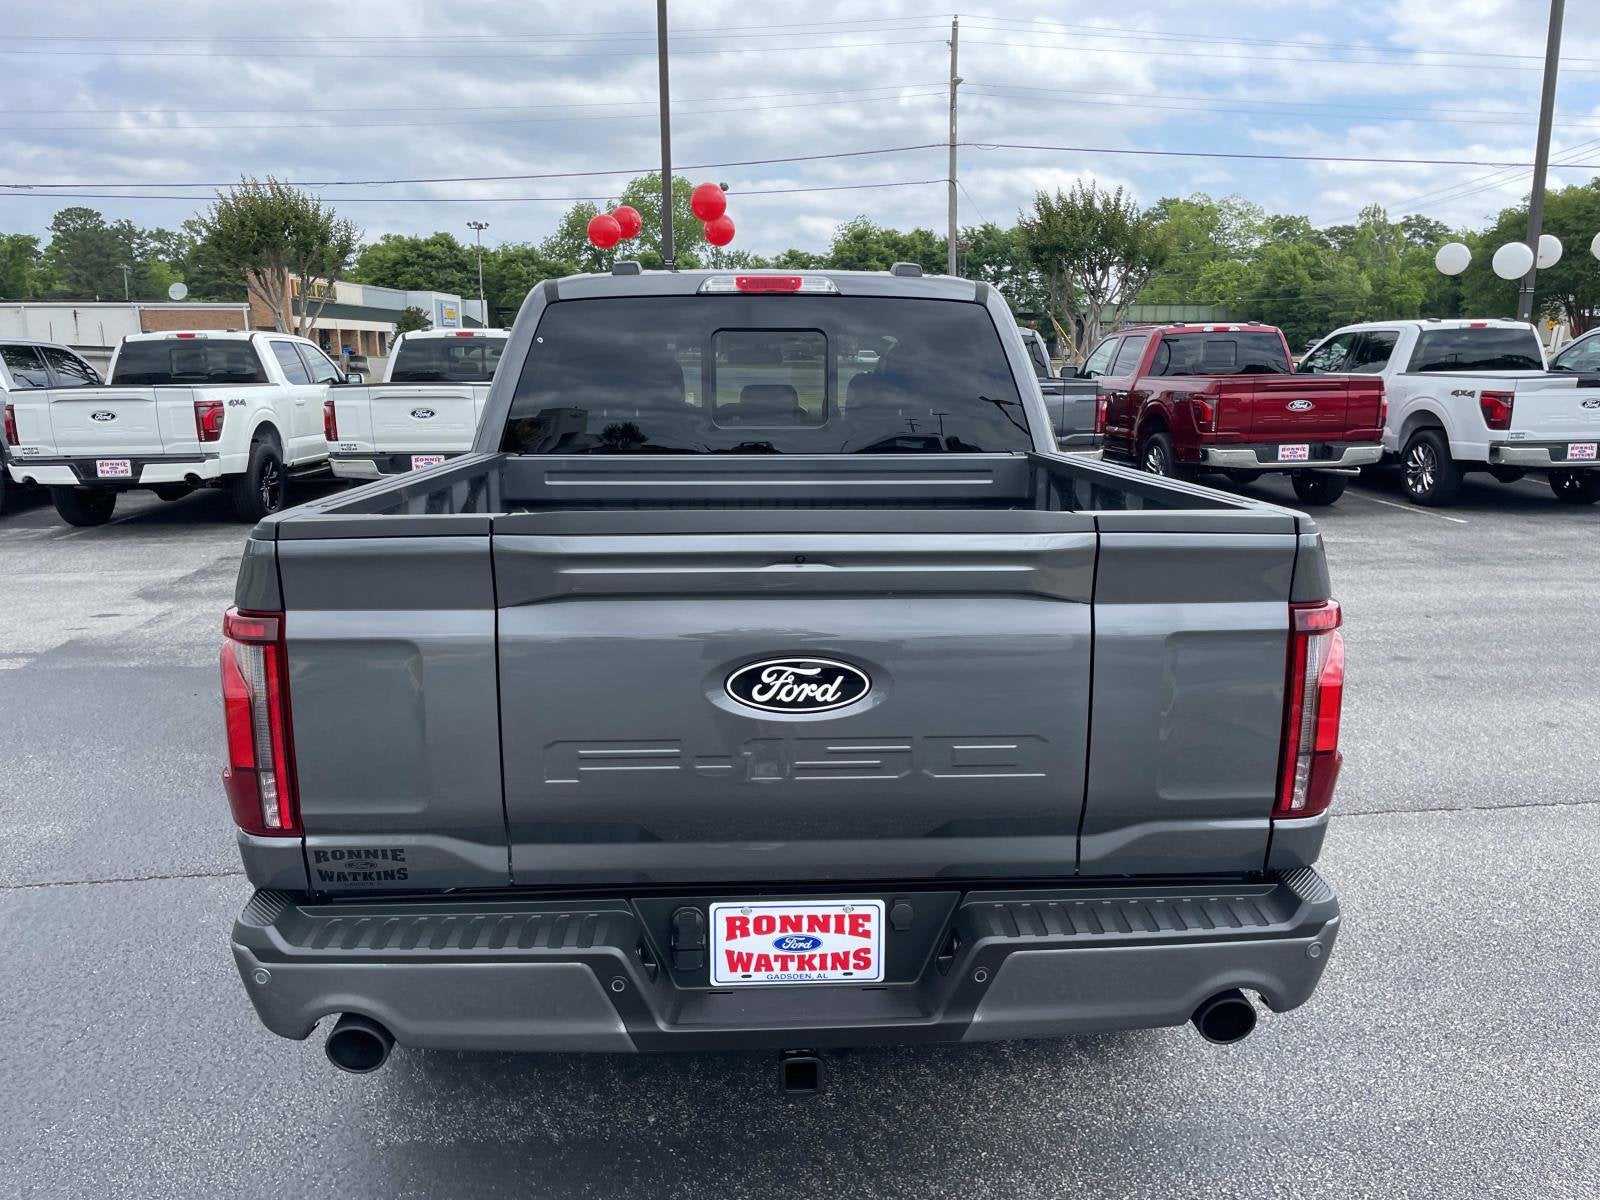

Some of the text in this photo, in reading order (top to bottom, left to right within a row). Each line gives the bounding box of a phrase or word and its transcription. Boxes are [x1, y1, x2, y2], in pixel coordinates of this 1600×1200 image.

[751, 664, 844, 703] Ford
[313, 848, 406, 864] RONNIE
[316, 867, 409, 882] WATKINS
[725, 913, 872, 942] RONNIE
[781, 936, 814, 950] Ford
[725, 947, 872, 973] WATKINS
[766, 973, 815, 981] GADSDEN,
